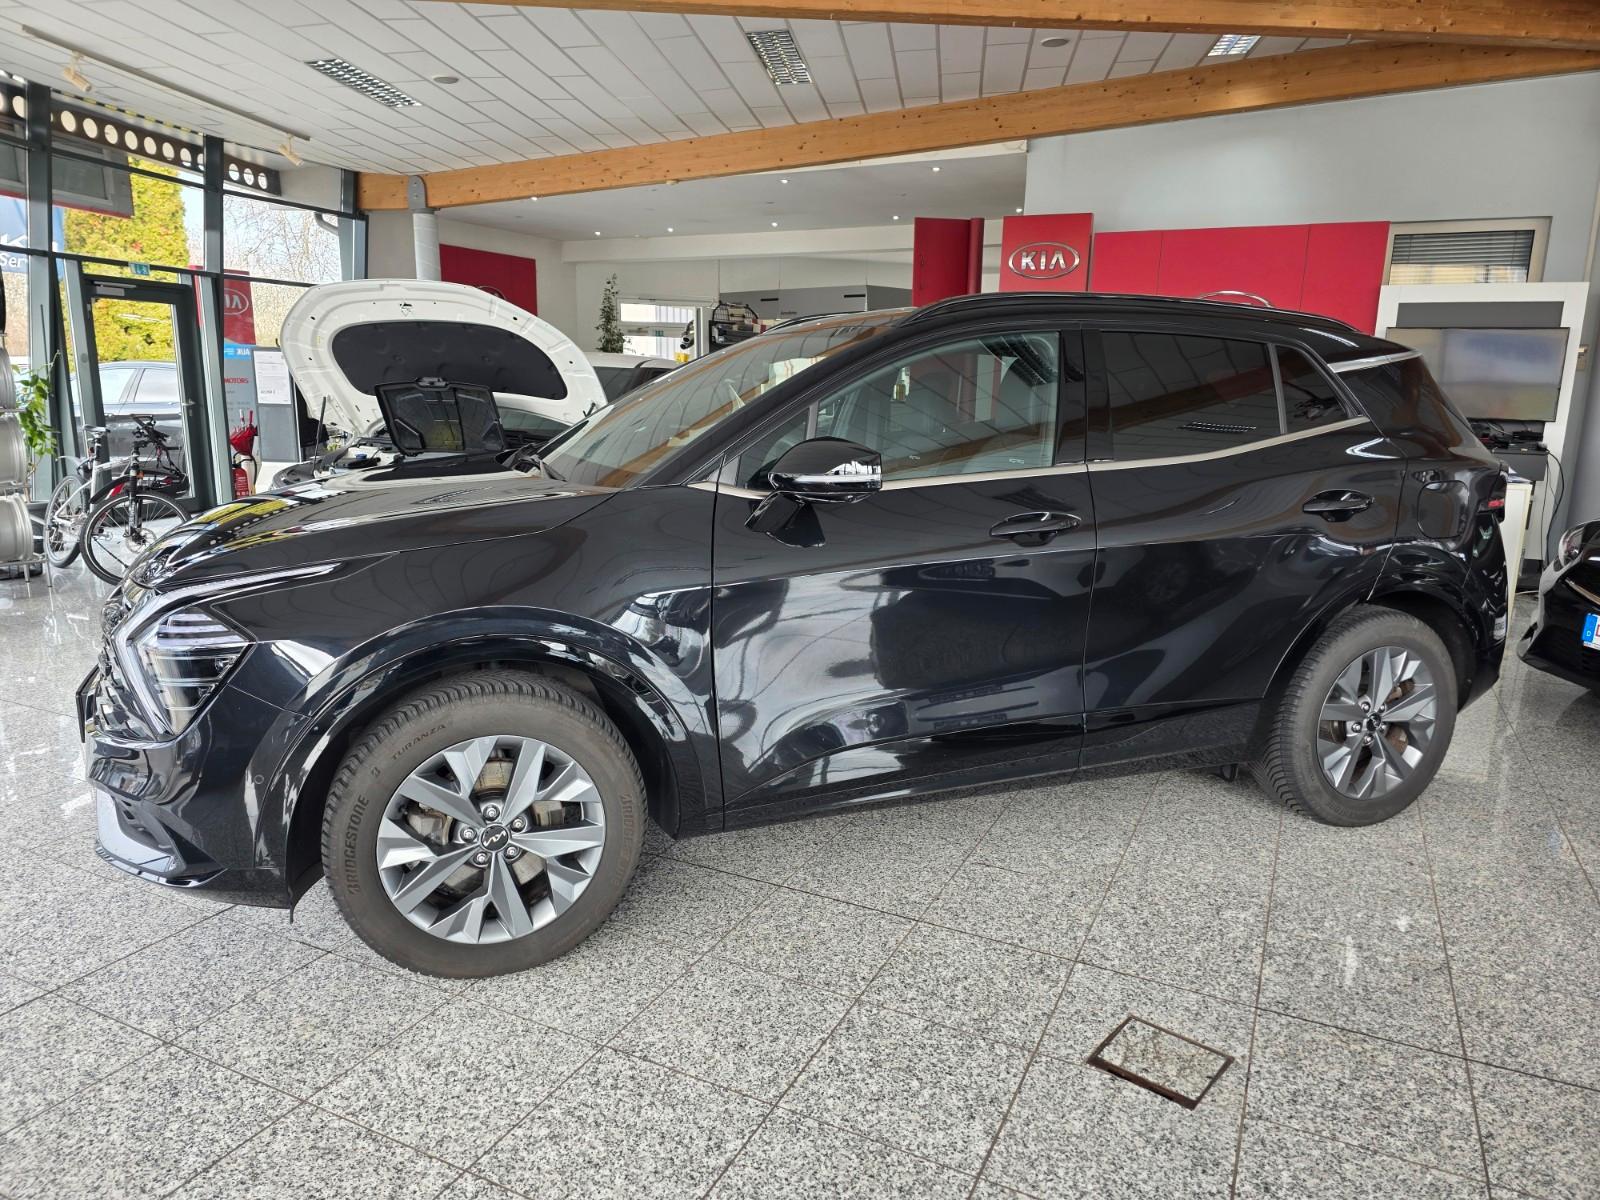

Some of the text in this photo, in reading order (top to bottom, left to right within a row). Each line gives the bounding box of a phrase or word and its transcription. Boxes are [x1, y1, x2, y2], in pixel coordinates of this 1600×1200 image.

[1021, 250, 1066, 271] KIA
[224, 293, 242, 309] IA
[392, 724, 446, 760] TURANZA
[343, 795, 370, 895] BRIDGESTONE
